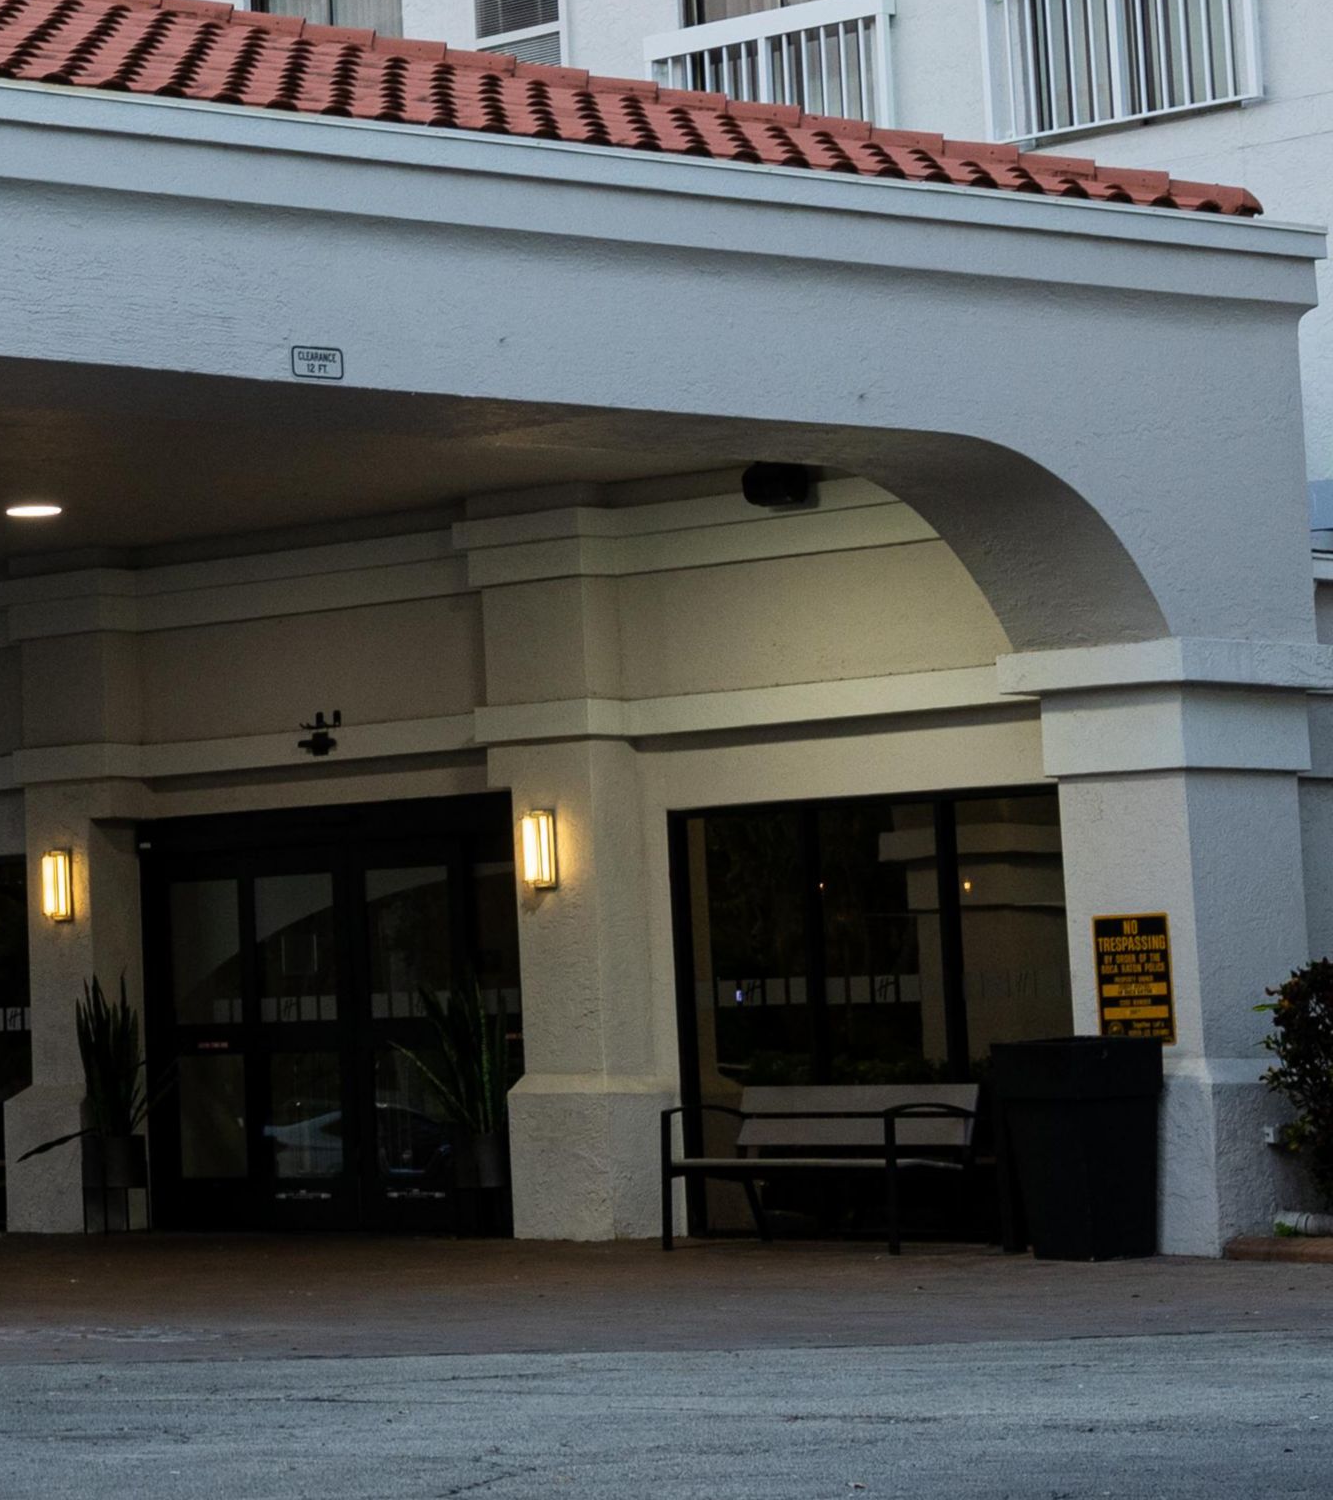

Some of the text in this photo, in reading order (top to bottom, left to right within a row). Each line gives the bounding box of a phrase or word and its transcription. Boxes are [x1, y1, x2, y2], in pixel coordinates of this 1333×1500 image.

[298, 351, 337, 363] CLEARANCE
[307, 363, 316, 373] 12
[1123, 920, 1138, 935] NO
[1098, 935, 1165, 952] TRESPASSING
